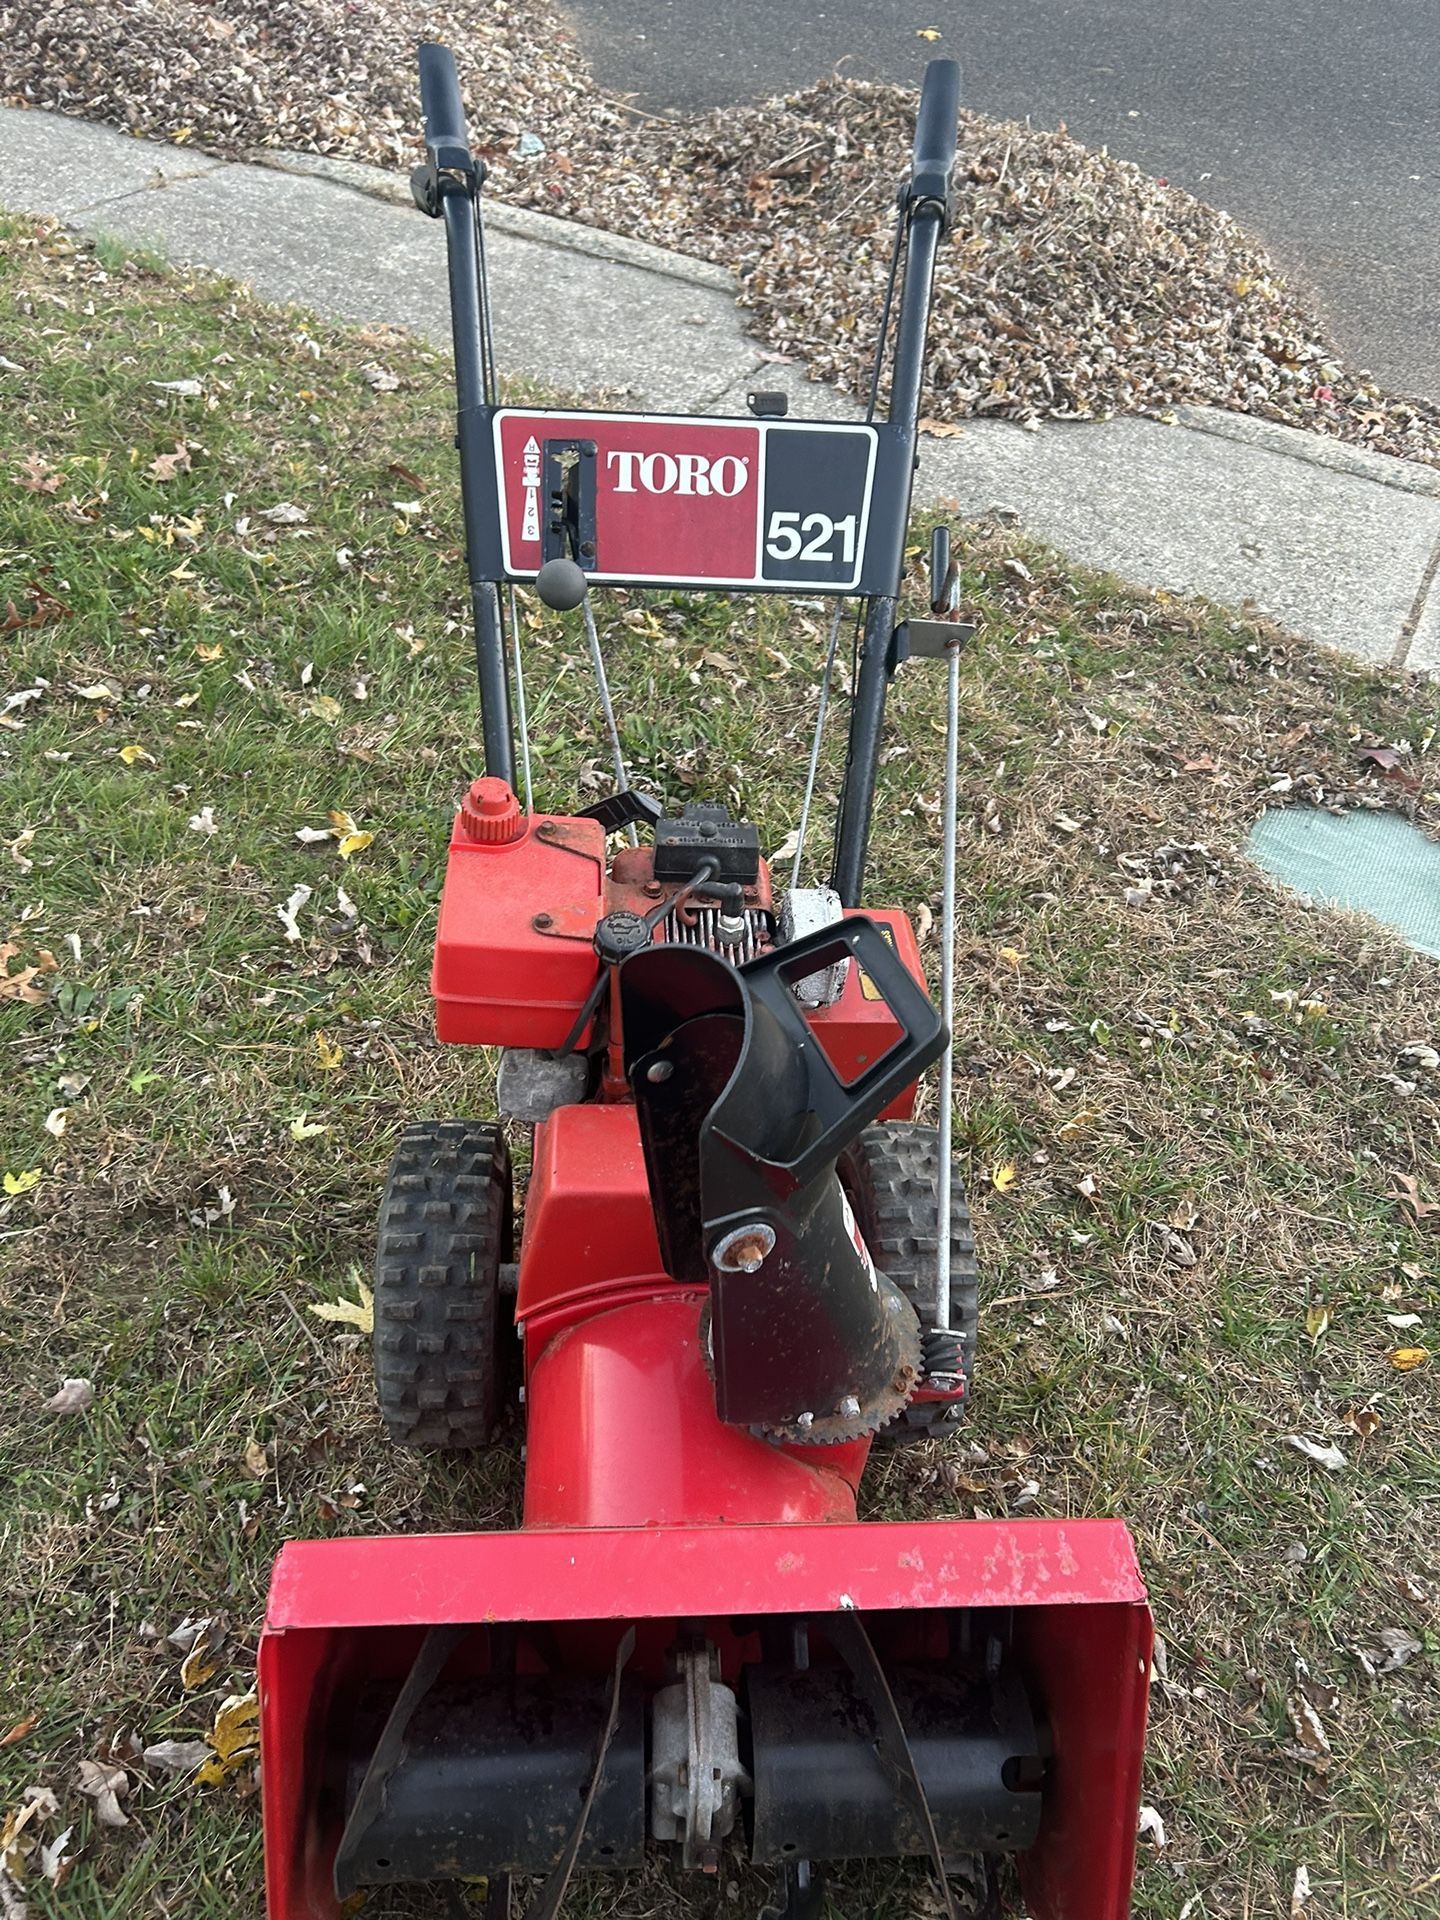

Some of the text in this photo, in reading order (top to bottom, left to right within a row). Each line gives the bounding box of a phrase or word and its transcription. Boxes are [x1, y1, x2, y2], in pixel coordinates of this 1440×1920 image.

[607, 451, 748, 497] TORO
[527, 507, 535, 517] 2
[527, 525, 535, 535] 3
[766, 511, 857, 563] 521
